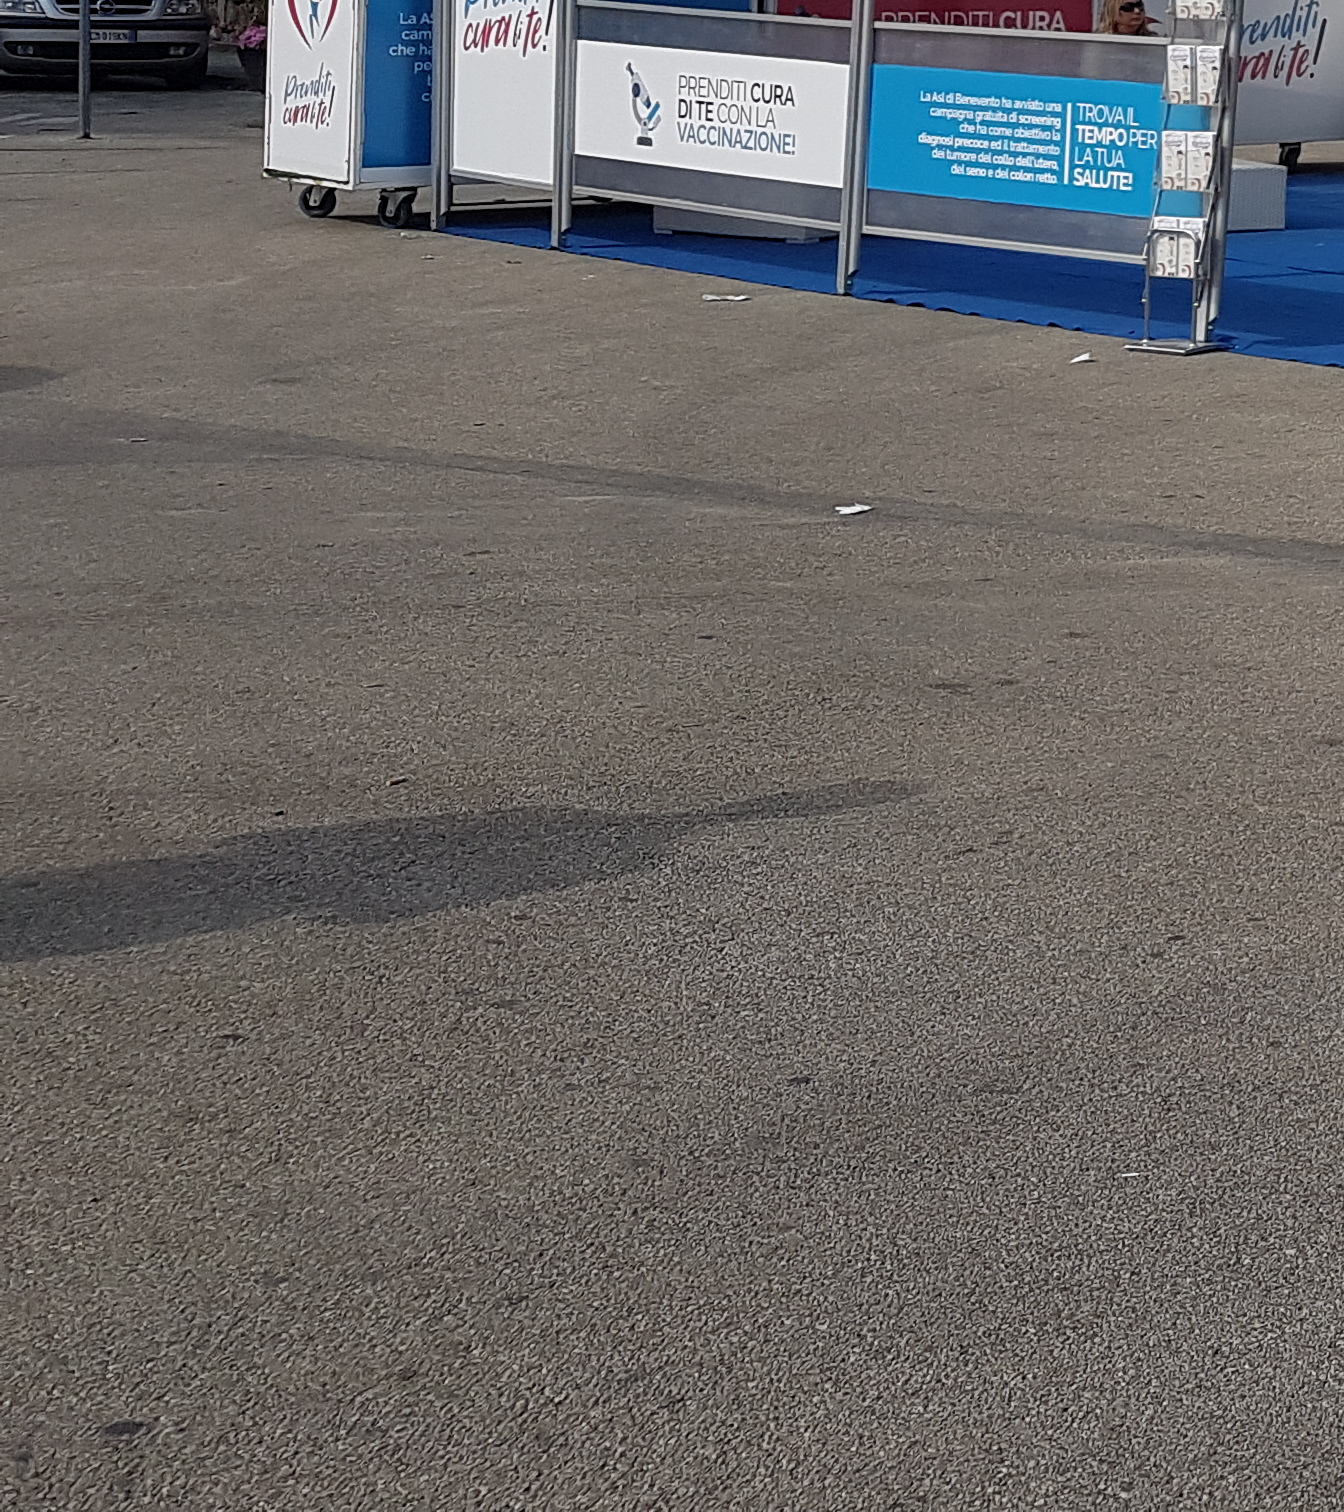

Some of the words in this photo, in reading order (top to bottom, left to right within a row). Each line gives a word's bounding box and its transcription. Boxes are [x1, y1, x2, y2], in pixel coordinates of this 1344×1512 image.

[400, 13, 416, 24] La
[1000, 11, 1066, 31] CURA
[464, 14, 512, 53] cura
[389, 44, 415, 55] che
[679, 75, 746, 102] PRENDITI
[751, 83, 795, 107] CURA
[920, 91, 930, 101] La
[946, 93, 954, 103] di
[956, 93, 1000, 107] Benevento
[1002, 97, 1012, 108] ha
[678, 99, 692, 119] DI
[695, 100, 714, 121] TE
[717, 103, 752, 126] CON
[756, 106, 776, 129] LA
[930, 107, 974, 121] campagna
[1018, 115, 1061, 129] screening
[1076, 103, 1125, 124] TROVA
[1127, 107, 1139, 126] IL
[677, 121, 795, 155] VACCINAZIONE!
[918, 132, 953, 145] diagnosi
[955, 137, 989, 148] precoce
[991, 139, 1001, 149] ed
[960, 123, 975, 133] che
[988, 126, 1012, 136] come
[1075, 125, 1127, 146] TEMPO
[1129, 129, 1157, 149] PER
[947, 149, 976, 161] tumore
[1074, 146, 1093, 165] LA
[1094, 147, 1125, 168] TUA
[966, 167, 986, 176] seno
[988, 169, 993, 177] e
[1073, 168, 1133, 191] SALUTE!
